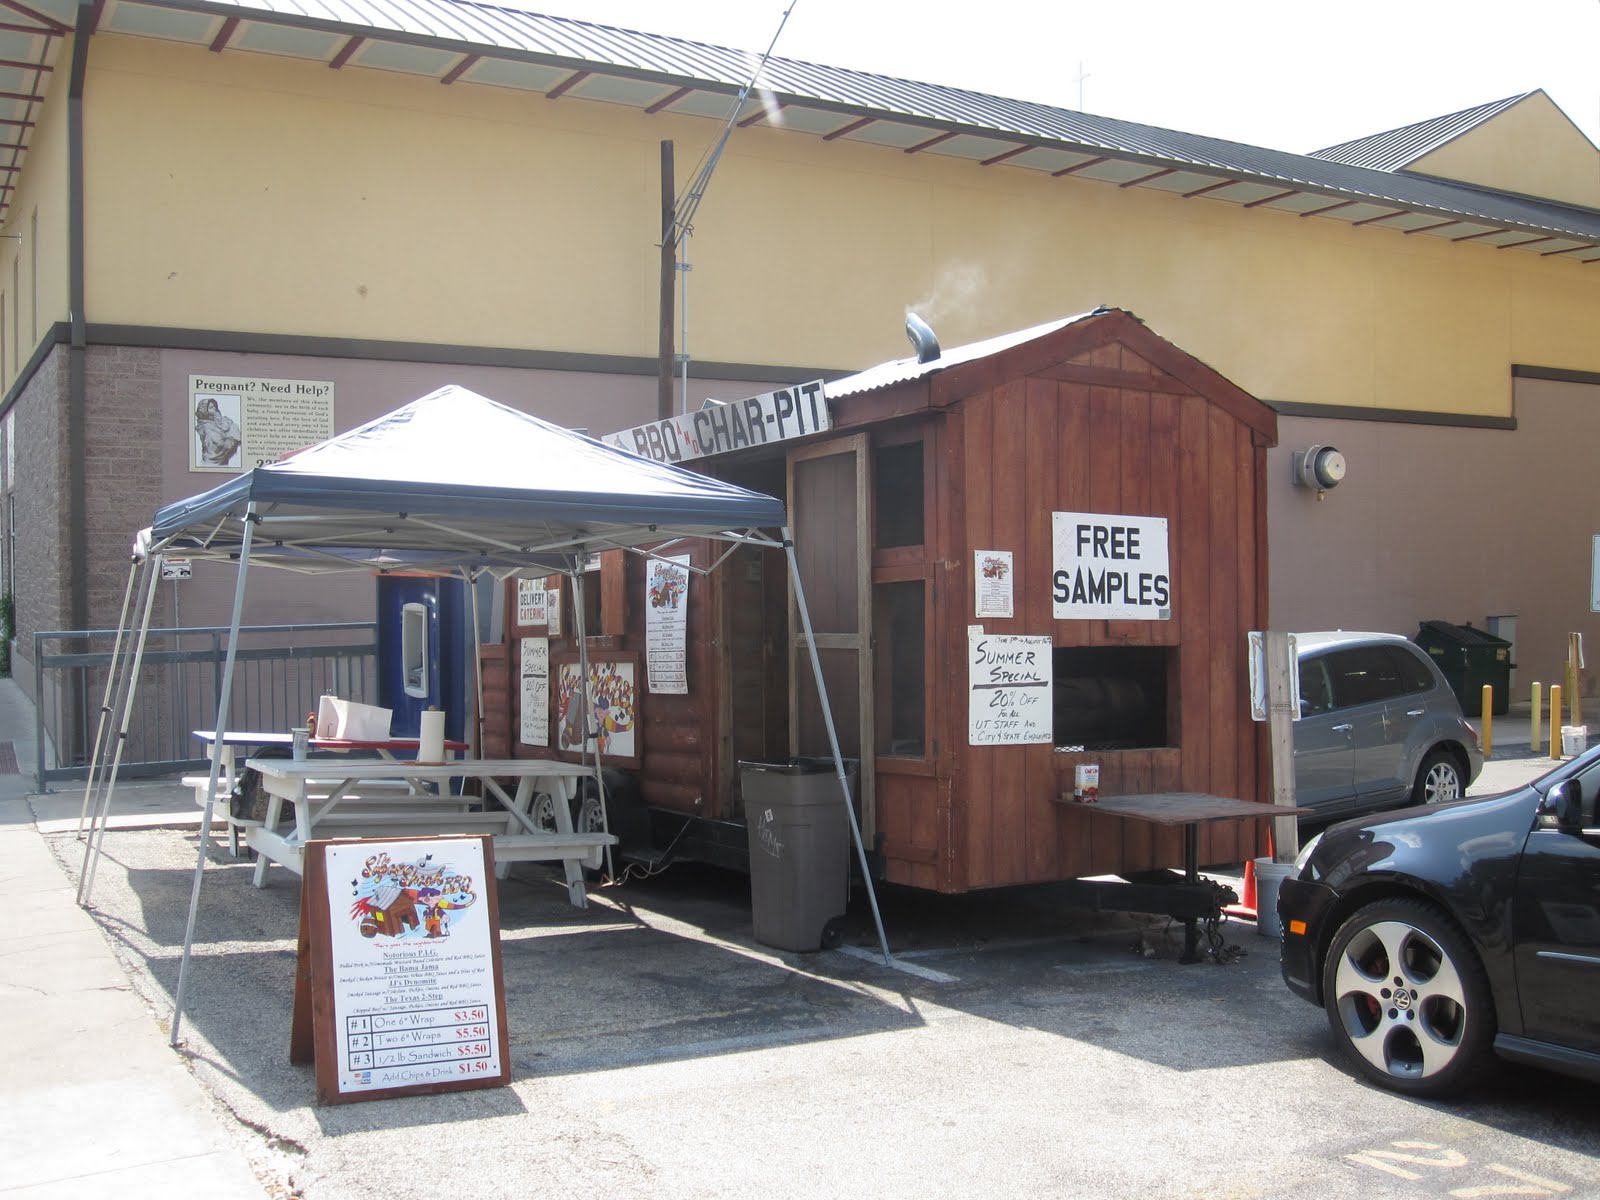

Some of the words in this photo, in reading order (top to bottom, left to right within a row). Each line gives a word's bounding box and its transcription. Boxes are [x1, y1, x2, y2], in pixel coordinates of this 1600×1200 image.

[195, 379, 256, 392] Pregnant?
[261, 382, 291, 394] Need
[296, 384, 329, 397] Help?
[693, 382, 821, 453] CHAR-PIT
[1076, 524, 1141, 560] FREE
[1053, 565, 1169, 607] SAMPLES
[520, 593, 545, 606] DELIVERY
[520, 607, 545, 620] CATERING
[975, 640, 1035, 666] SUMMER
[990, 666, 1041, 682] SPECIAL
[989, 690, 1017, 708] 20%
[976, 720, 991, 729] UT
[994, 720, 1019, 729] STAFF
[1004, 732, 1020, 740] STATE
[383, 951, 417, 960] Notorious
[385, 966, 398, 974] The
[399, 964, 419, 972] Bama
[421, 963, 439, 971] Jama
[390, 979, 404, 988] JJ's
[385, 996, 398, 1004] The
[400, 994, 420, 1002] Texas
[421, 992, 444, 1001] 2-Step
[362, 1018, 368, 1029] 1
[374, 1016, 396, 1029] One
[410, 1012, 435, 1026] Wrap
[454, 1009, 485, 1022] $3.50
[363, 1035, 370, 1046] 2
[375, 1033, 398, 1046] Two
[411, 1029, 442, 1042] Wraps
[456, 1026, 486, 1039] $5.50
[364, 1053, 371, 1065] 3
[379, 1053, 396, 1065] 1/2
[397, 1050, 406, 1062] lb
[408, 1050, 452, 1063] Sandwich
[457, 1043, 487, 1056] $5.50
[382, 1072, 400, 1083] Add
[400, 1069, 424, 1082] Chips
[433, 1066, 454, 1079] Drink
[458, 1061, 488, 1075] $1.50
